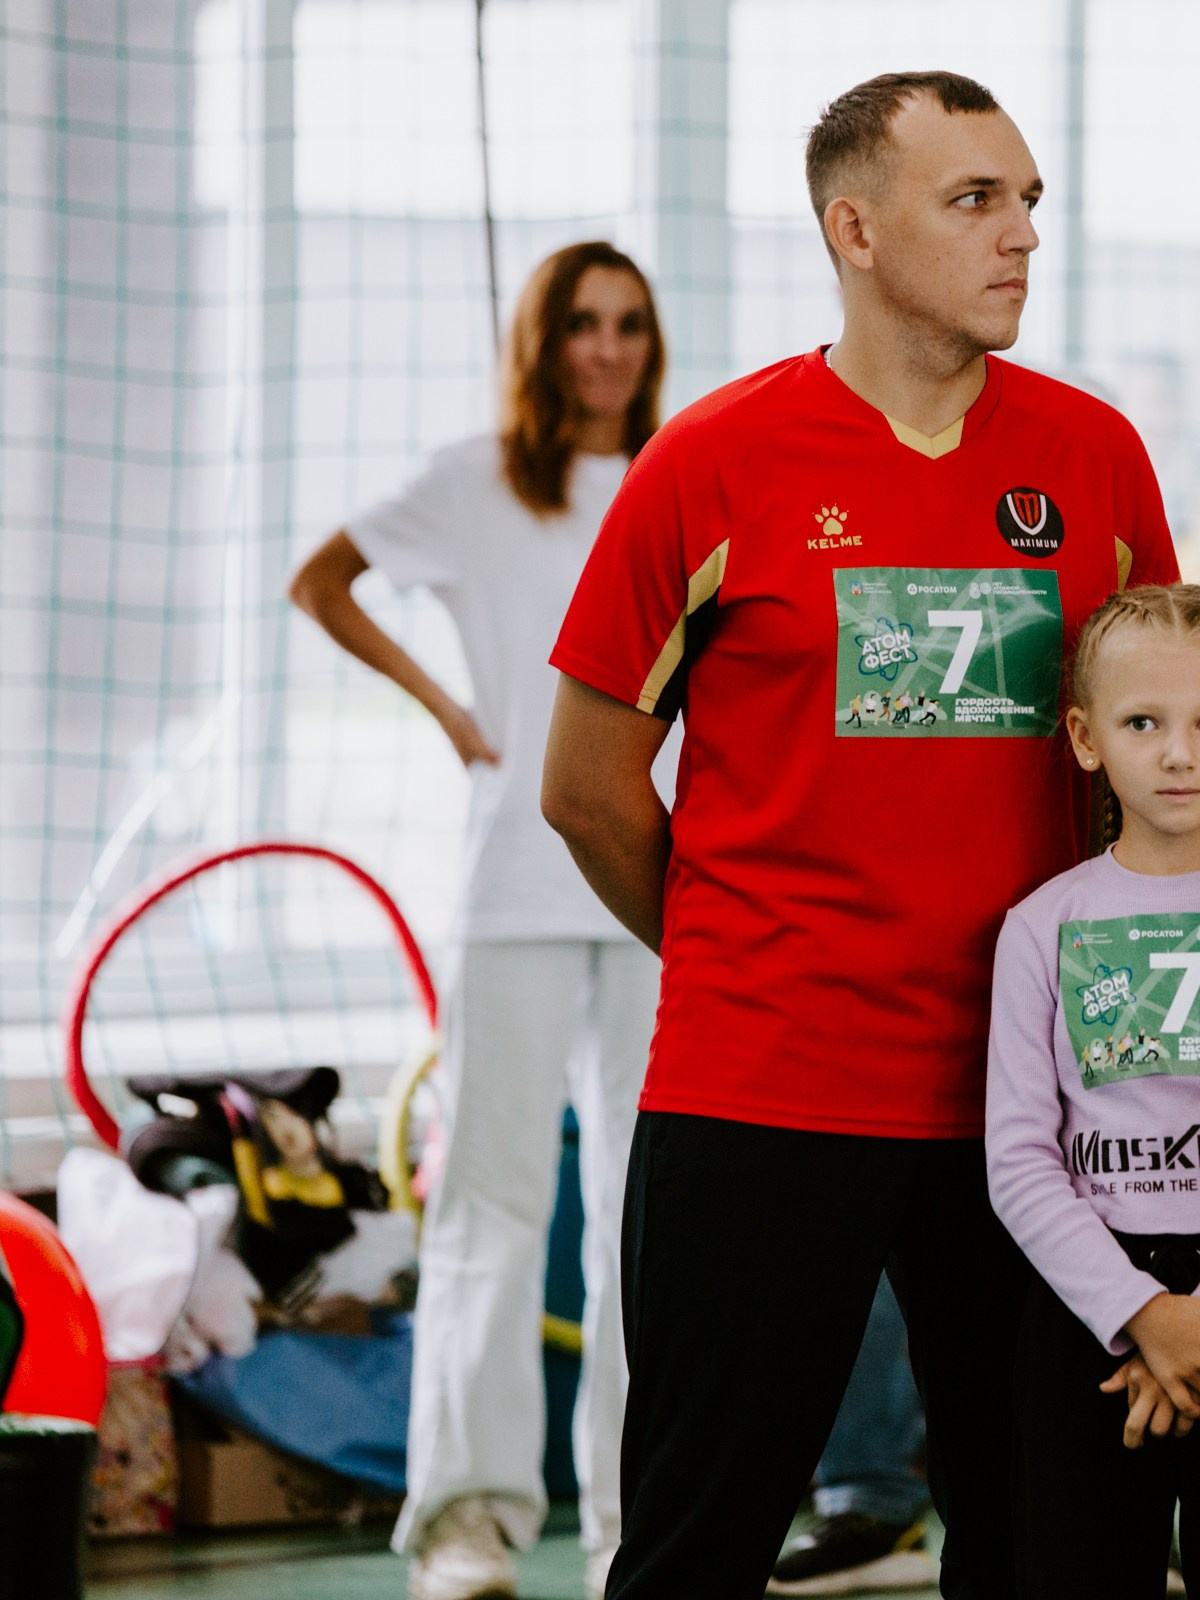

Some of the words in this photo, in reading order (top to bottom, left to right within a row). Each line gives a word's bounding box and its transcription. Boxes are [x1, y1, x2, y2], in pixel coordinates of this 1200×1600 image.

[807, 535, 863, 550] KELME
[1010, 538, 1059, 549] MAXIMUM
[918, 586, 957, 594] РОСАТОМ
[861, 631, 911, 655] АТОМ
[864, 645, 911, 669] ФЕСТ
[927, 610, 983, 694] 7
[955, 706, 1035, 714] ВДОХНОВЕНИЕ
[955, 714, 995, 722] МЕЧТА!
[1141, 930, 1184, 938] РОСАТОМ
[1083, 973, 1128, 1003] АТОМ
[1085, 986, 1130, 1018] ФЕСТ
[1124, 1180, 1165, 1194] FROM
[1169, 1178, 1198, 1192] THE
